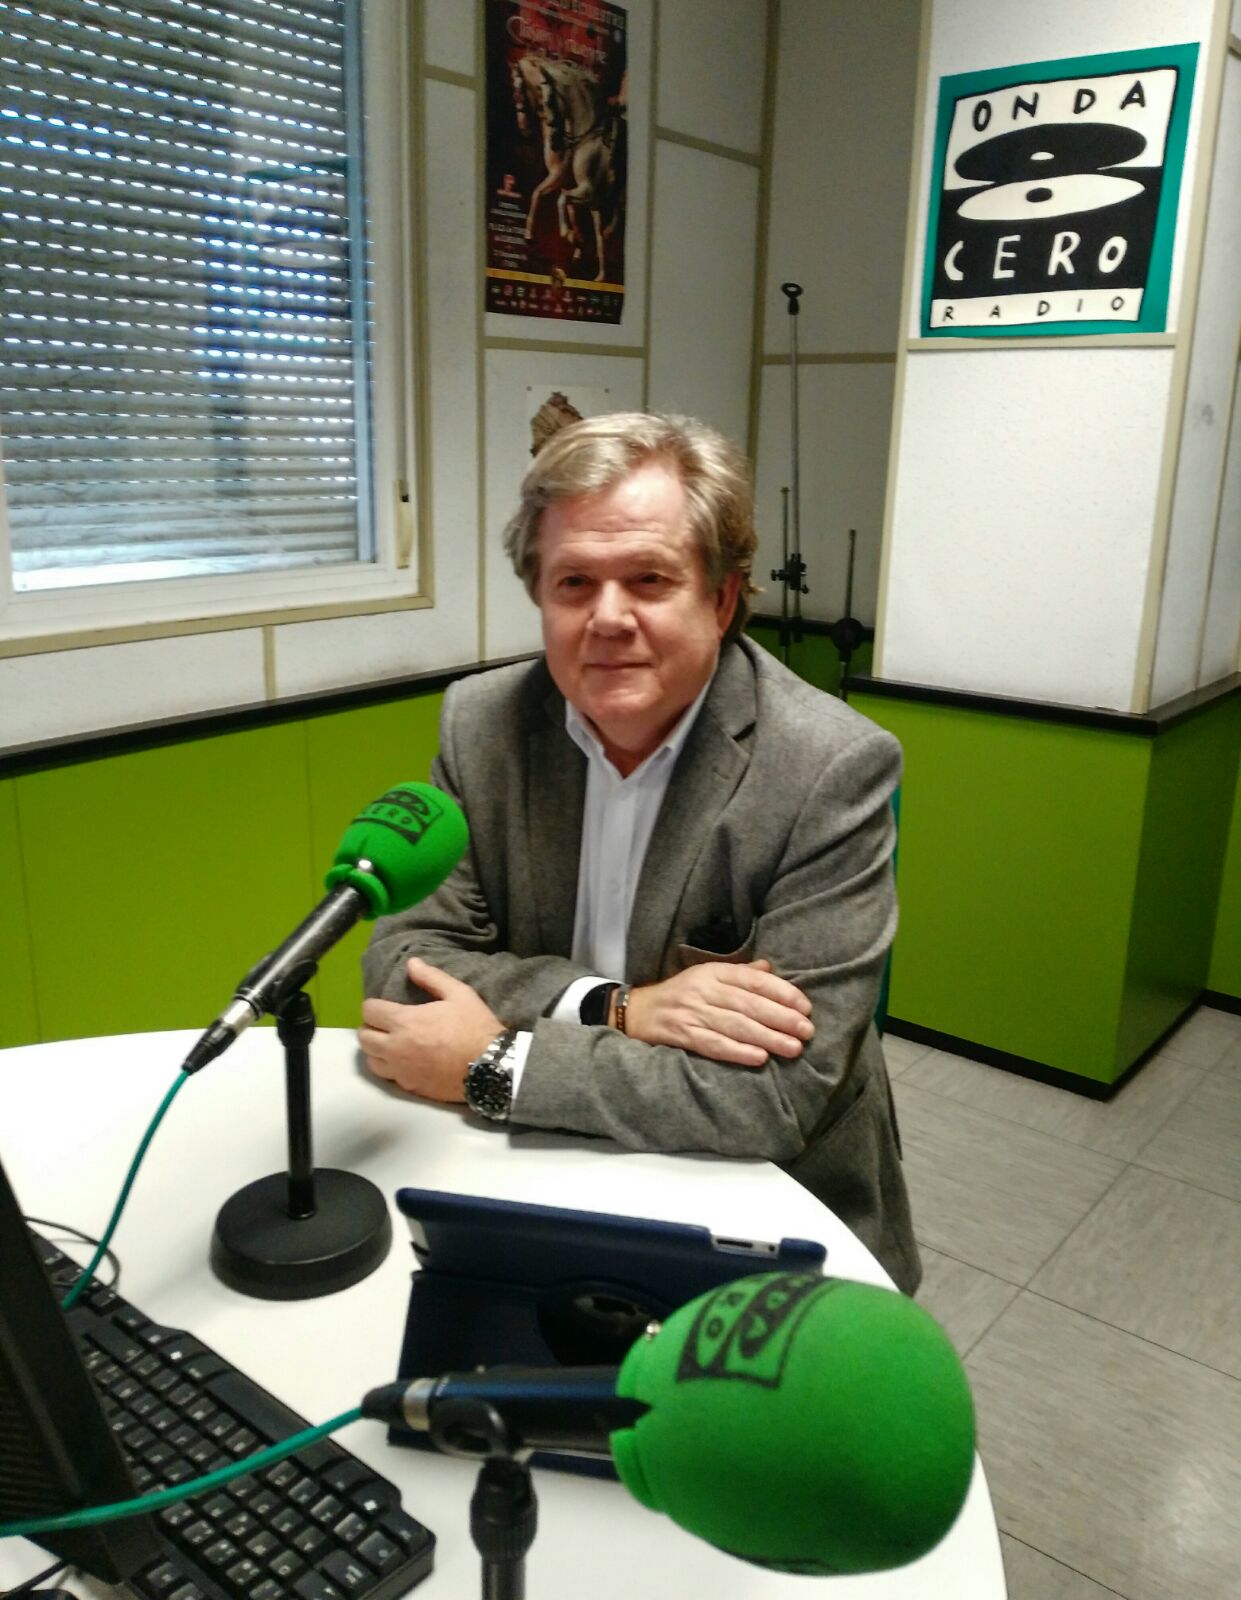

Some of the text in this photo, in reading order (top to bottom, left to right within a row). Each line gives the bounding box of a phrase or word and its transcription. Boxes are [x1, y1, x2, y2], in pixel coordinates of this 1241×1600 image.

[972, 79, 1146, 132] ONDA
[944, 231, 1128, 281] CERO
[942, 296, 1125, 322] RADIO
